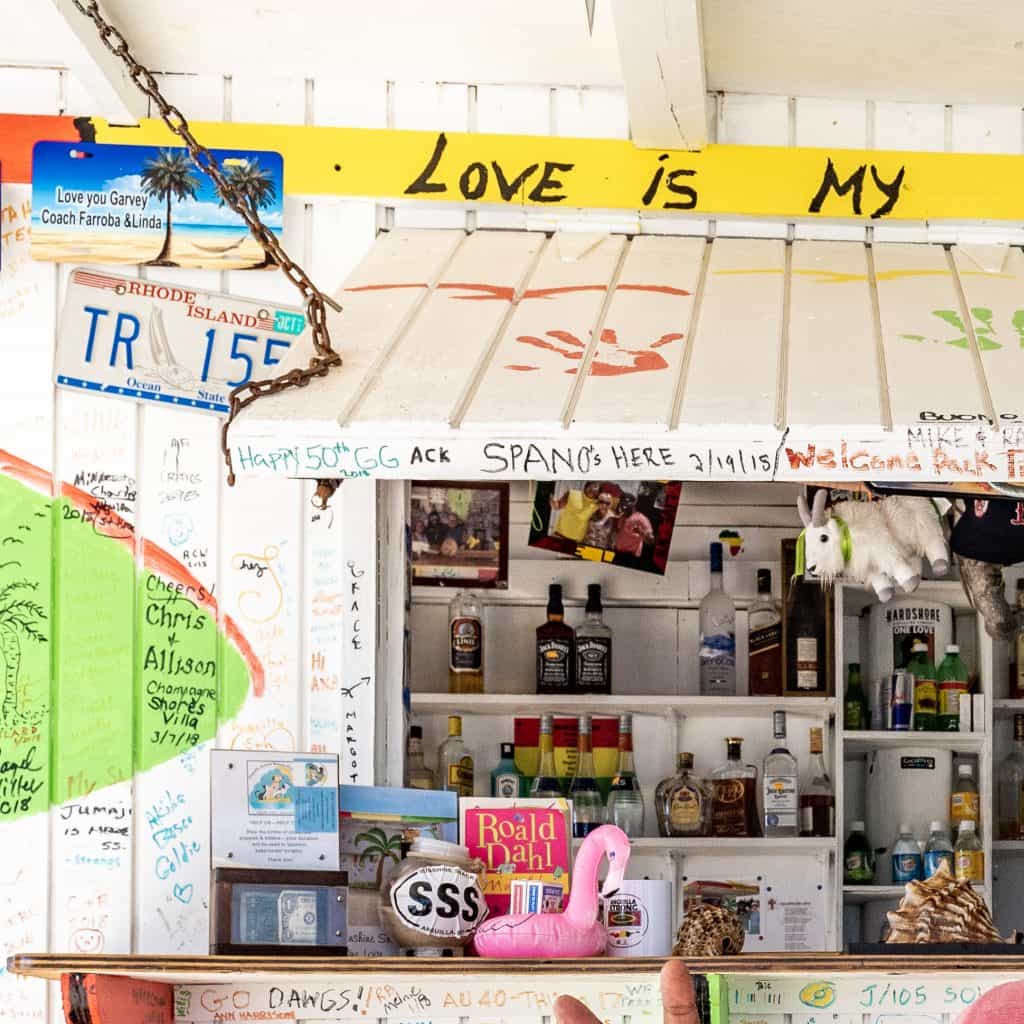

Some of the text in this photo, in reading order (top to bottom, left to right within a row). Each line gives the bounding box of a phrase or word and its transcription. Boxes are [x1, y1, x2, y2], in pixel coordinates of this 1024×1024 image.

[404, 133, 575, 202] LOVE
[808, 159, 905, 219] MY
[57, 187, 149, 211] Love you Garvey
[41, 209, 77, 228] Coach
[79, 211, 121, 229] Farroba
[128, 281, 197, 306] RHODE
[186, 304, 258, 328] ISLAND
[82, 306, 141, 371] TR
[126, 377, 226, 403] Ocean State
[238, 441, 676, 475] Happy 50th GG ACK HERE
[146, 574, 216, 602] Cheers!
[145, 603, 208, 632] Chris
[143, 645, 216, 678] Allison
[146, 679, 217, 698] Champagne
[147, 696, 206, 716] Shores
[162, 712, 199, 730] Villa
[150, 730, 201, 747] 3/7/18
[476, 811, 558, 849] Roald
[485, 841, 553, 872] Dahl
[407, 880, 480, 922] SSS
[199, 988, 251, 1013] GO
[860, 984, 927, 1007] J/105
